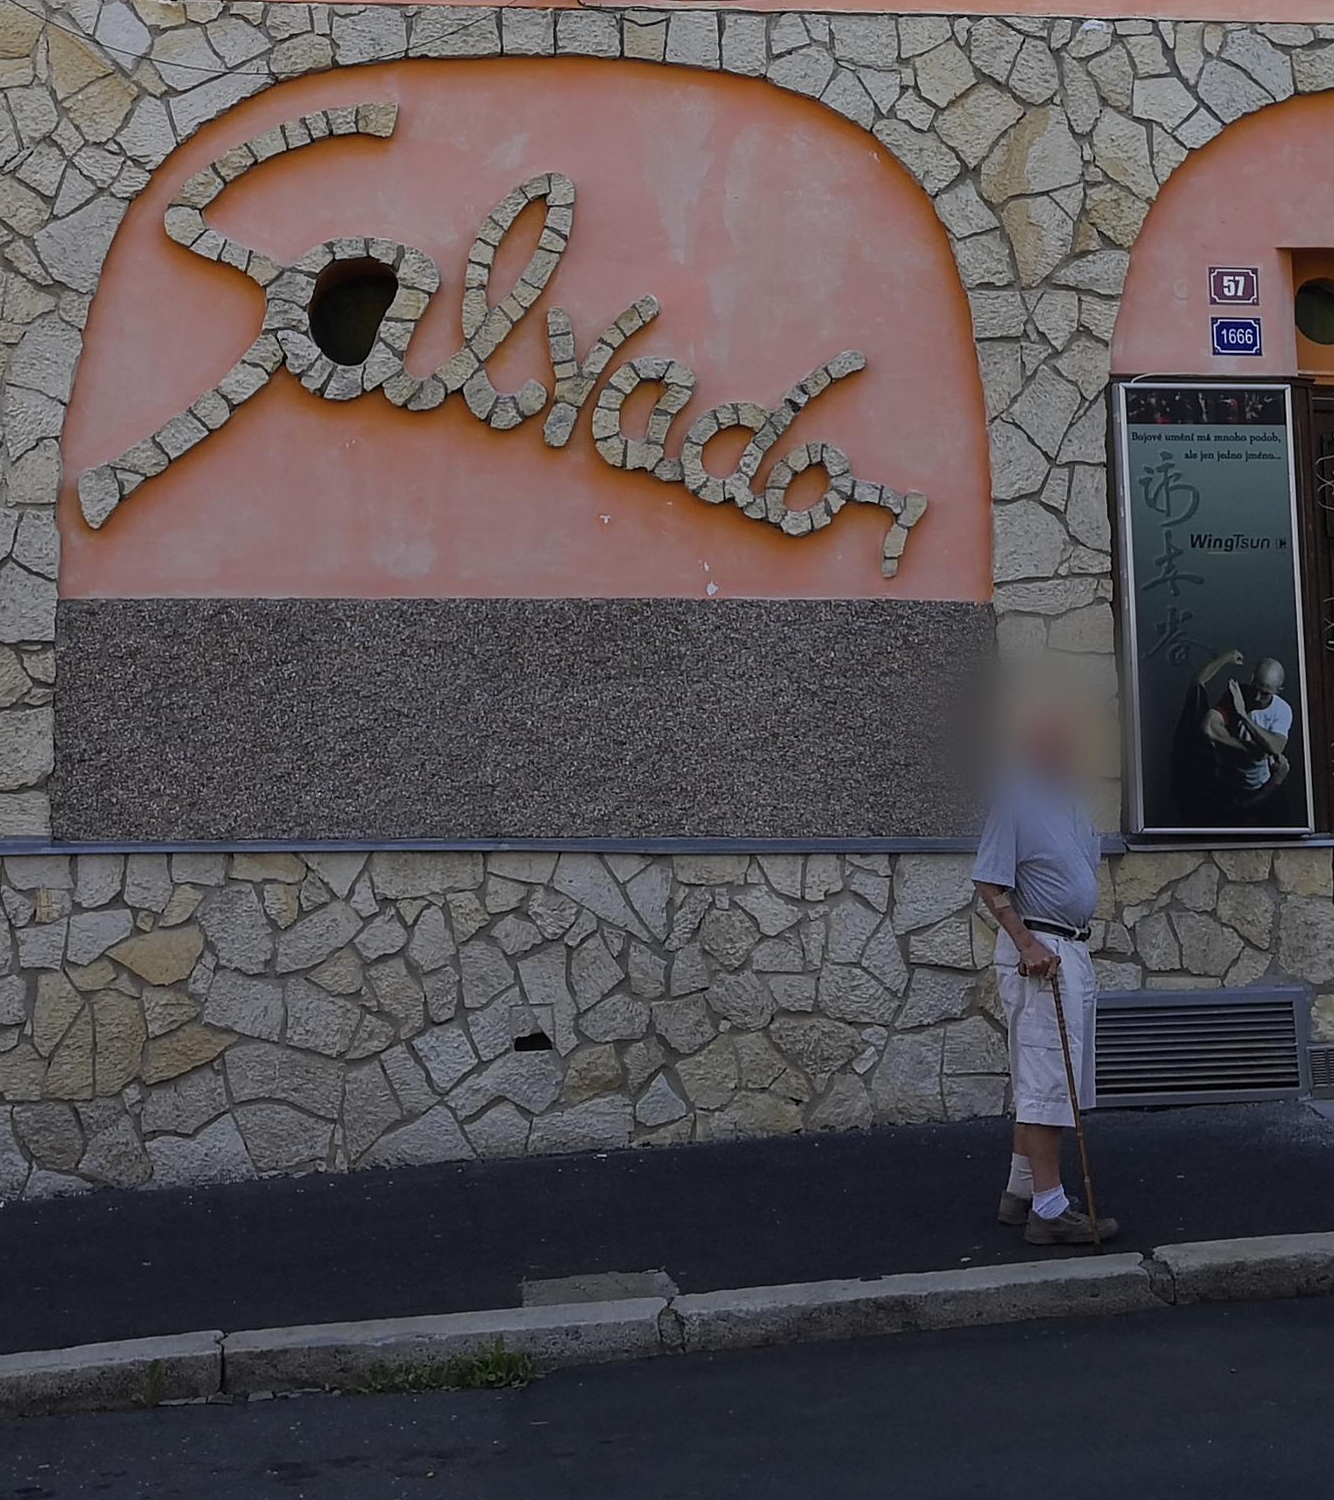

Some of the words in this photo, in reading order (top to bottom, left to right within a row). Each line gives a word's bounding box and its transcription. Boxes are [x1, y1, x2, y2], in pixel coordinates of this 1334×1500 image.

[1222, 275, 1245, 296] 57
[78, 101, 929, 578] Salvador
[1221, 328, 1254, 344] 1666
[1131, 431, 1162, 444] Bojové
[1196, 432, 1212, 441] má
[1214, 431, 1247, 441] mnoho
[1249, 431, 1282, 445] podob,
[1184, 449, 1198, 460] ale
[1200, 450, 1214, 462] jen
[1217, 449, 1243, 462] jedno
[1190, 533, 1270, 552] WingTsun
